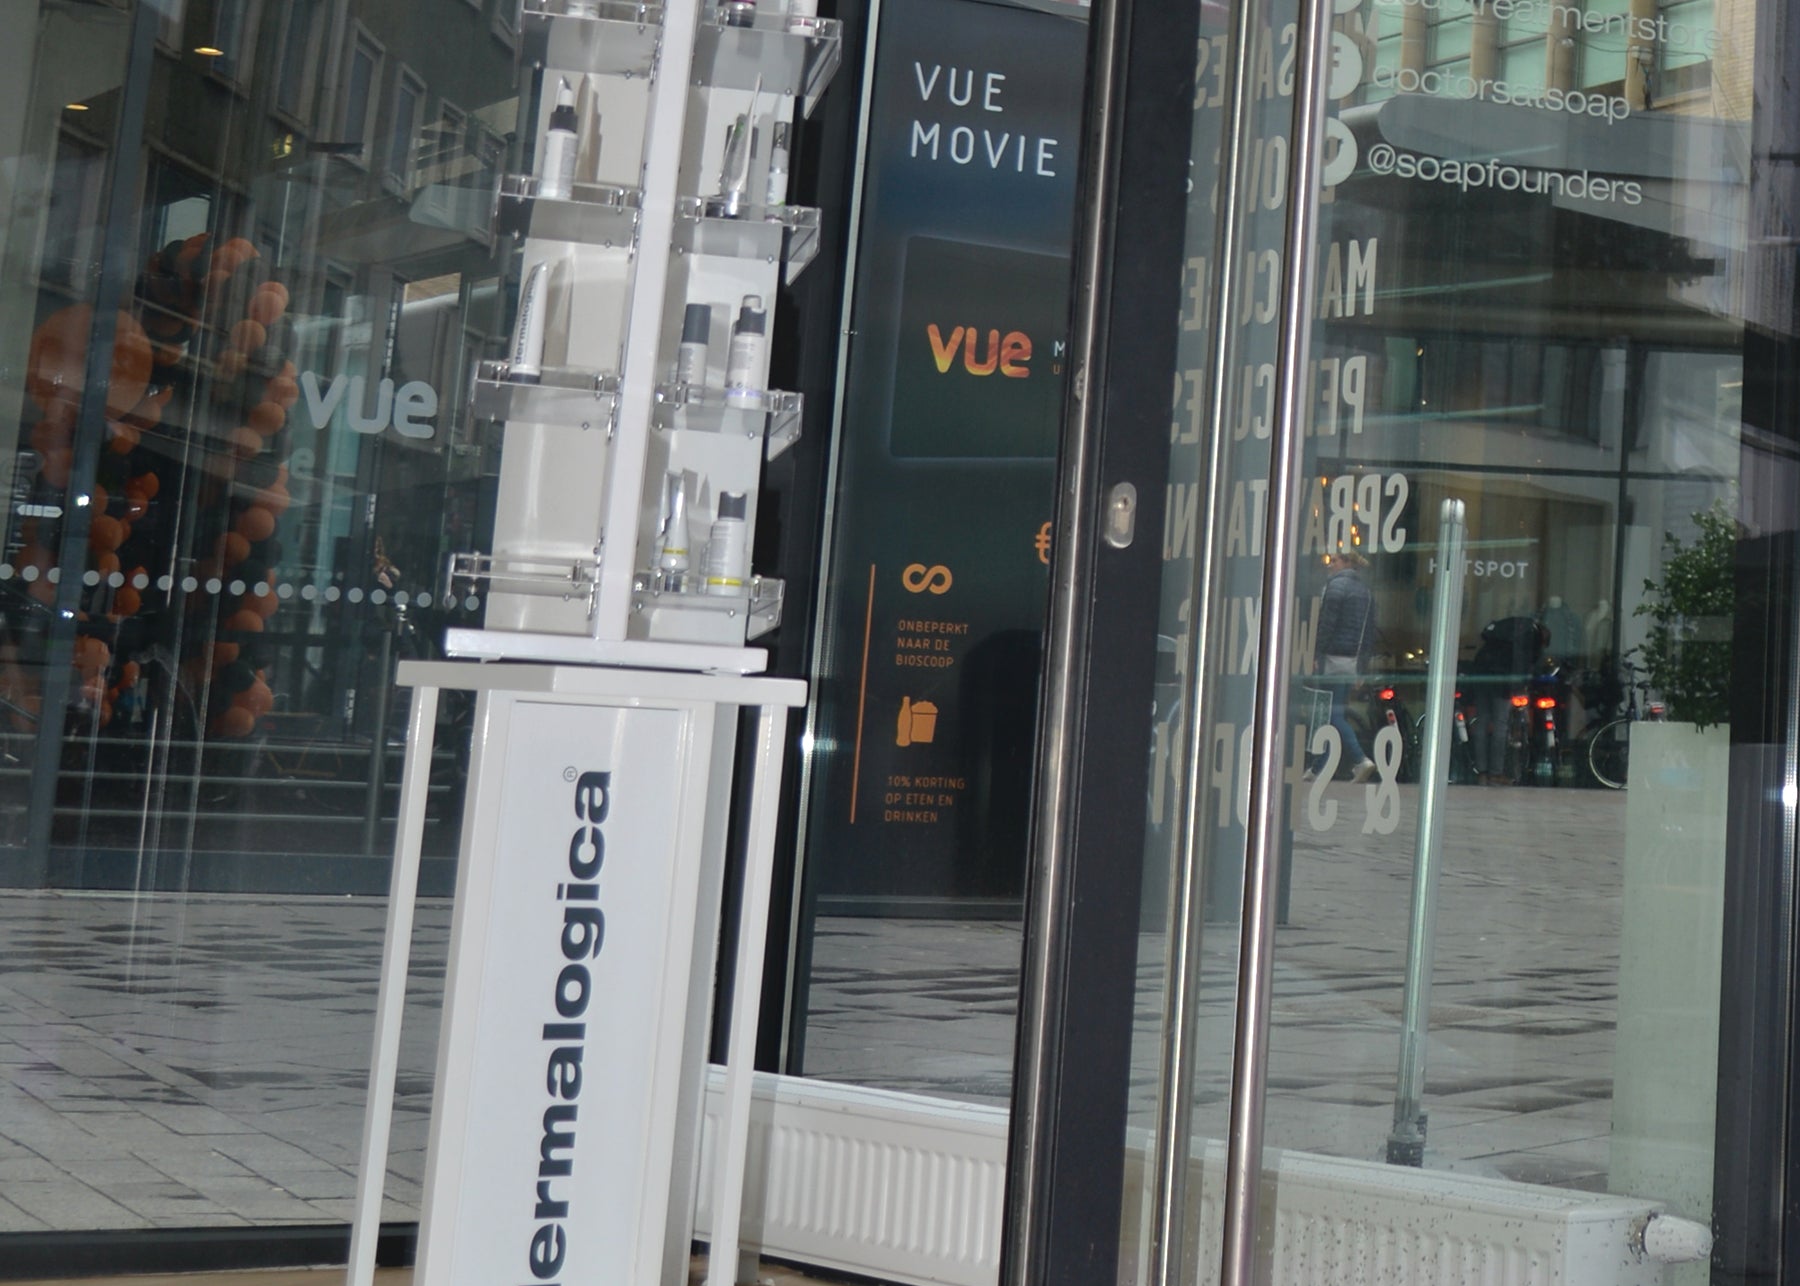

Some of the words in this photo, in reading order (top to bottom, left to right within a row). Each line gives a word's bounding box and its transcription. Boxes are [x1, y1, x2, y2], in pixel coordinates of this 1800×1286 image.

[1376, 0, 1723, 52] treatmentstore
[915, 61, 1006, 112] VUE
[911, 119, 1058, 177] MOVIE
[1367, 143, 1643, 206] @soapfounders
[927, 324, 1032, 378] vue
[302, 371, 438, 439] vue
[1429, 558, 1529, 578] HTSPOT
[898, 619, 969, 635] ONBEPERKT
[897, 637, 930, 650] NAAR
[934, 638, 951, 652] DE
[895, 654, 954, 668] BIOSCOOP
[887, 775, 912, 788] 10%
[914, 776, 966, 790] KORTING
[885, 792, 902, 805] OP
[905, 793, 934, 806] ETEN
[938, 794, 954, 807] EN
[884, 809, 939, 823] DRINKEN
